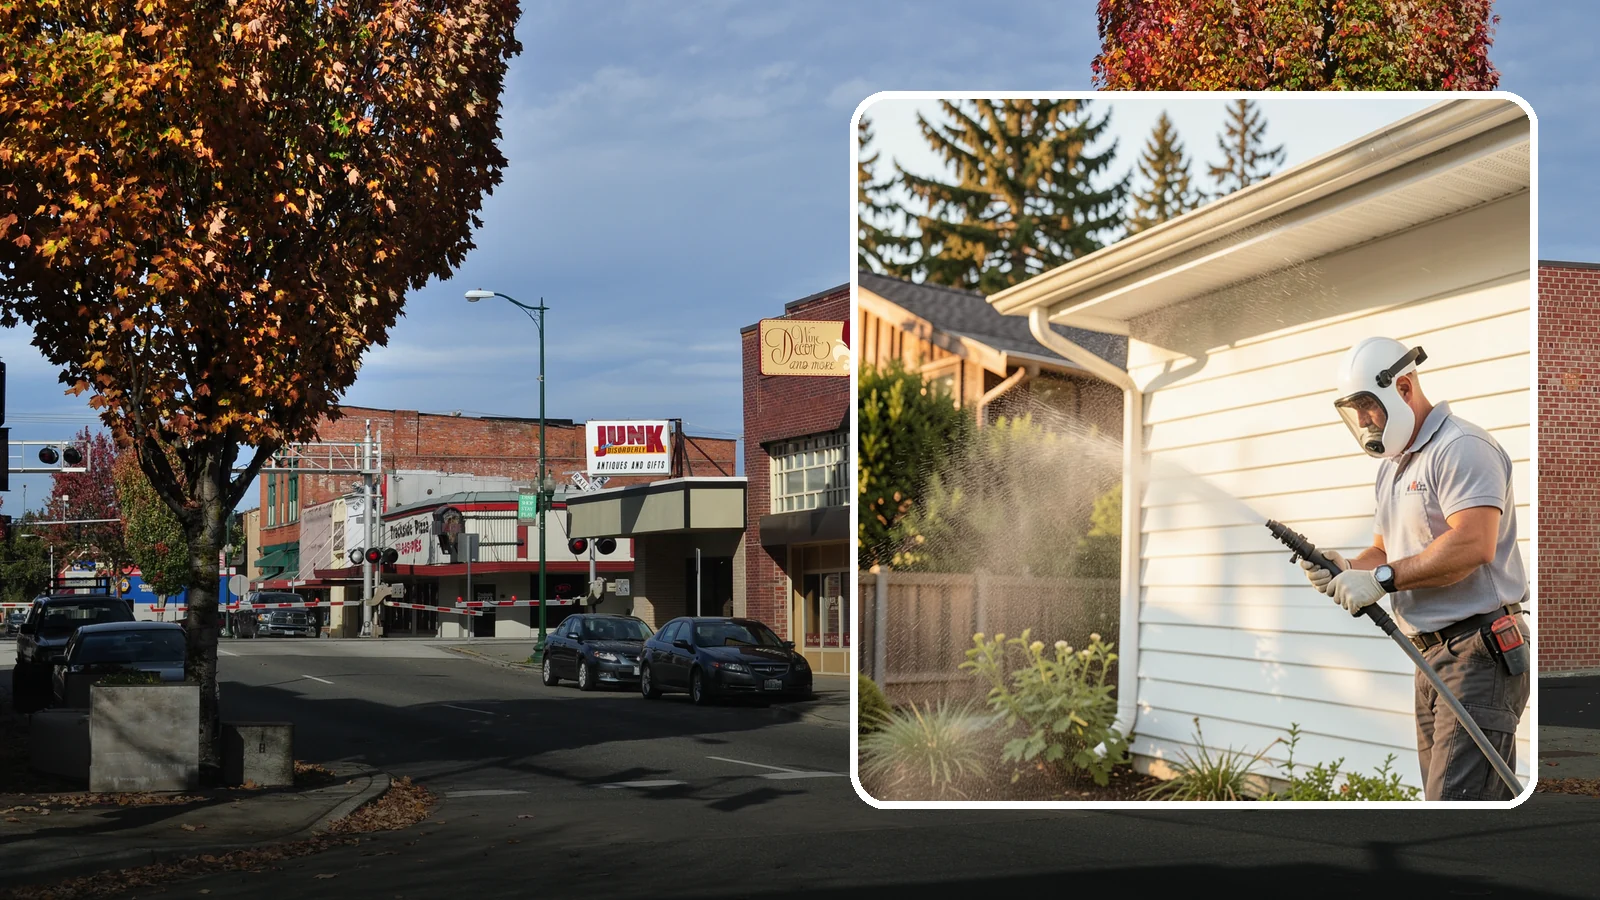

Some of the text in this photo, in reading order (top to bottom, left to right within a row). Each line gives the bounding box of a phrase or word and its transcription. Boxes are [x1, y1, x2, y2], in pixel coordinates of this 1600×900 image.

[596, 425, 665, 457] JUNK
[607, 446, 646, 454] DISORDERLY
[596, 460, 665, 470] ANTIQUES AND GIFTS
[390, 520, 429, 539] Trackside Pizza
